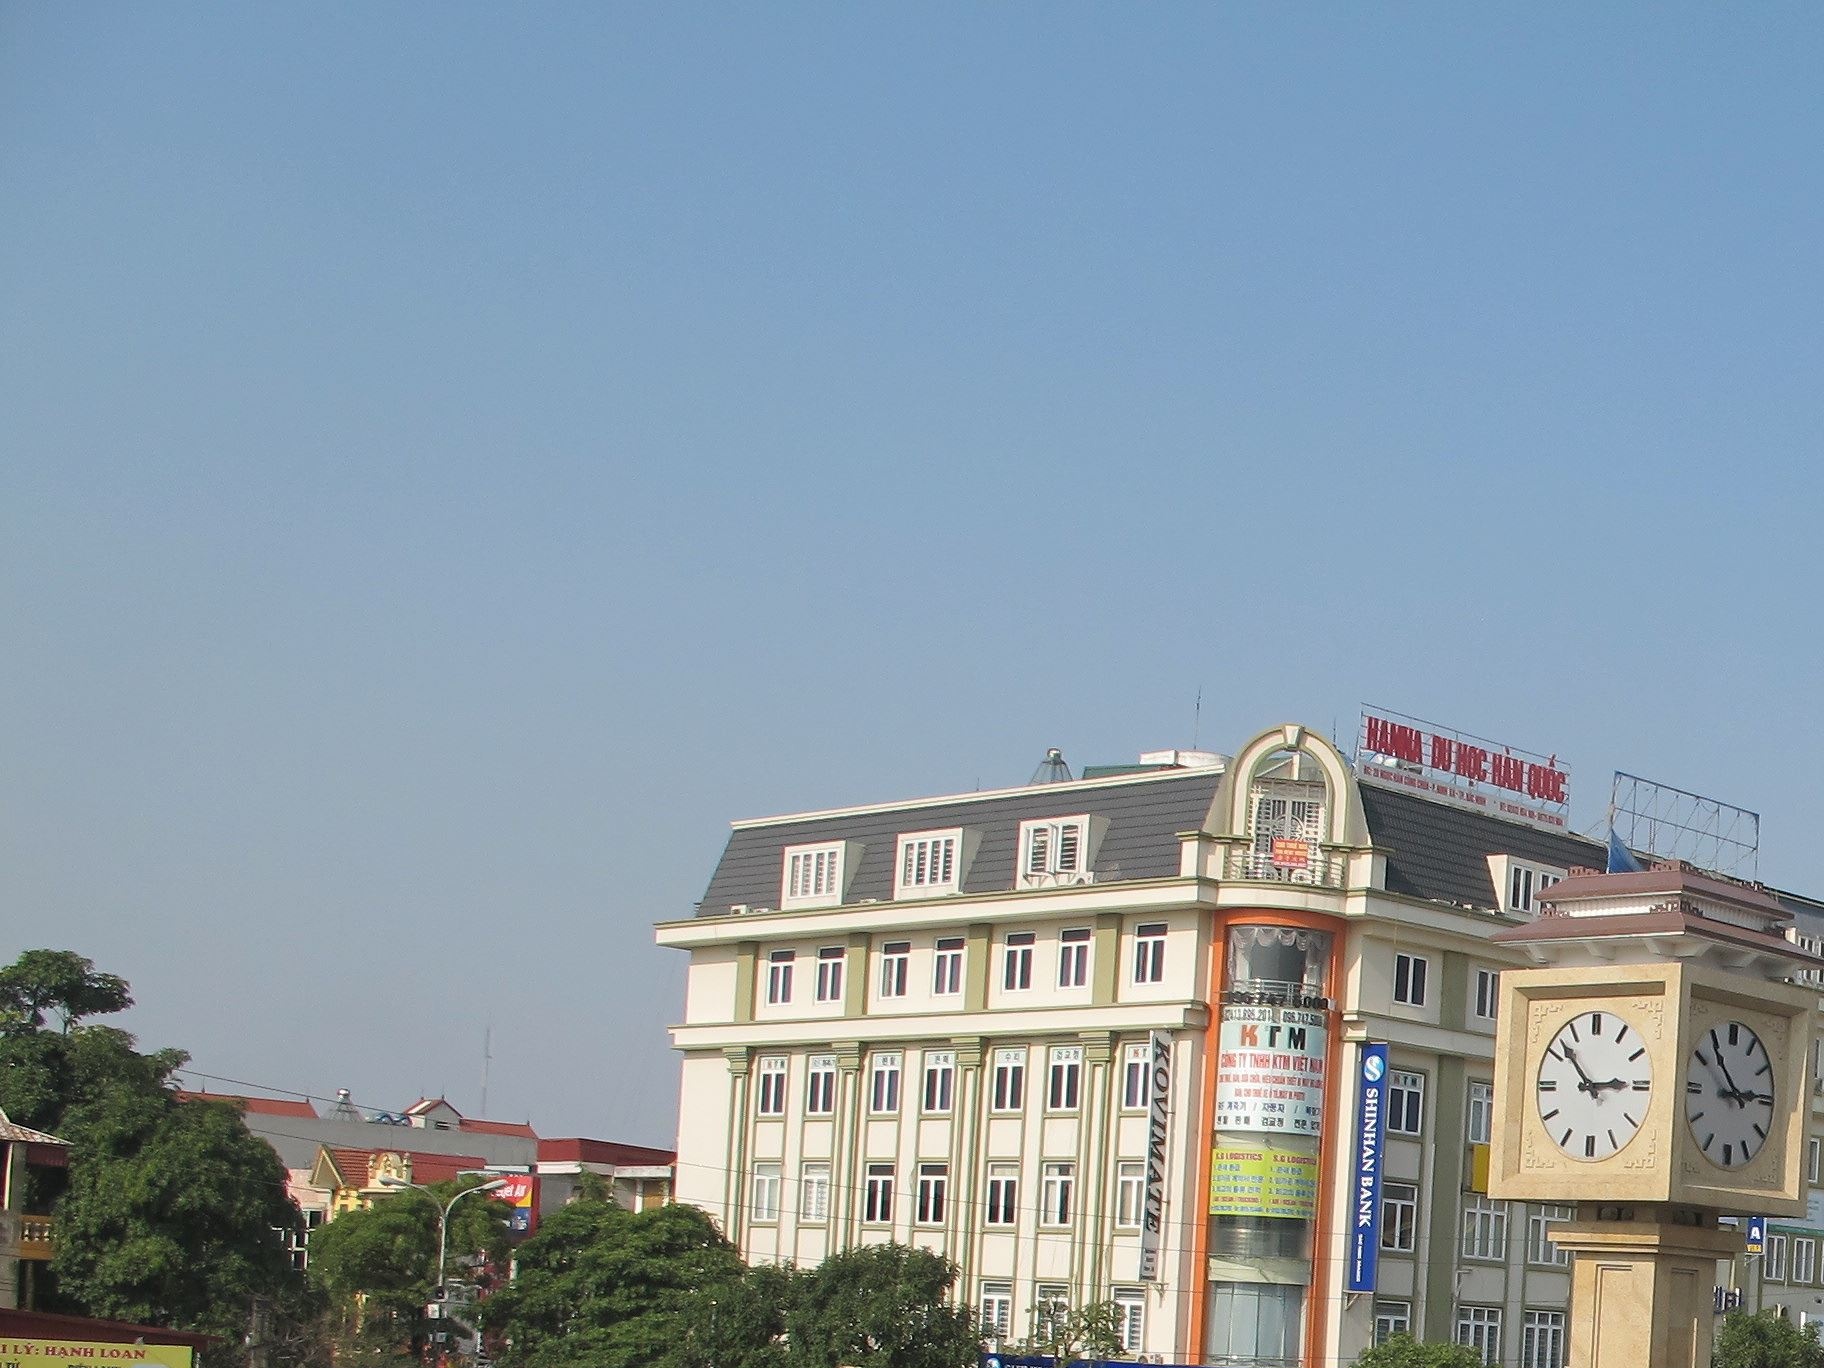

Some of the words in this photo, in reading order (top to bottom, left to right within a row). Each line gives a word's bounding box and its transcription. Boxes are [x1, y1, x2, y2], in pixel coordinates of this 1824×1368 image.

[1367, 716, 1423, 764] HANNA
[1431, 735, 1451, 772] DU
[1456, 742, 1488, 787] HỌC
[1492, 746, 1524, 793] HÀN
[1528, 754, 1567, 803] QUỐC
[1240, 1024, 1307, 1051] KTM
[1146, 1036, 1170, 1235] KOVIMATE
[1361, 1087, 1379, 1173] SHINHAN
[1358, 1176, 1376, 1228] BANK
[14, 1342, 39, 1355] LÝ:
[45, 1346, 94, 1359] HẠNH
[100, 1348, 145, 1360] LOAN
